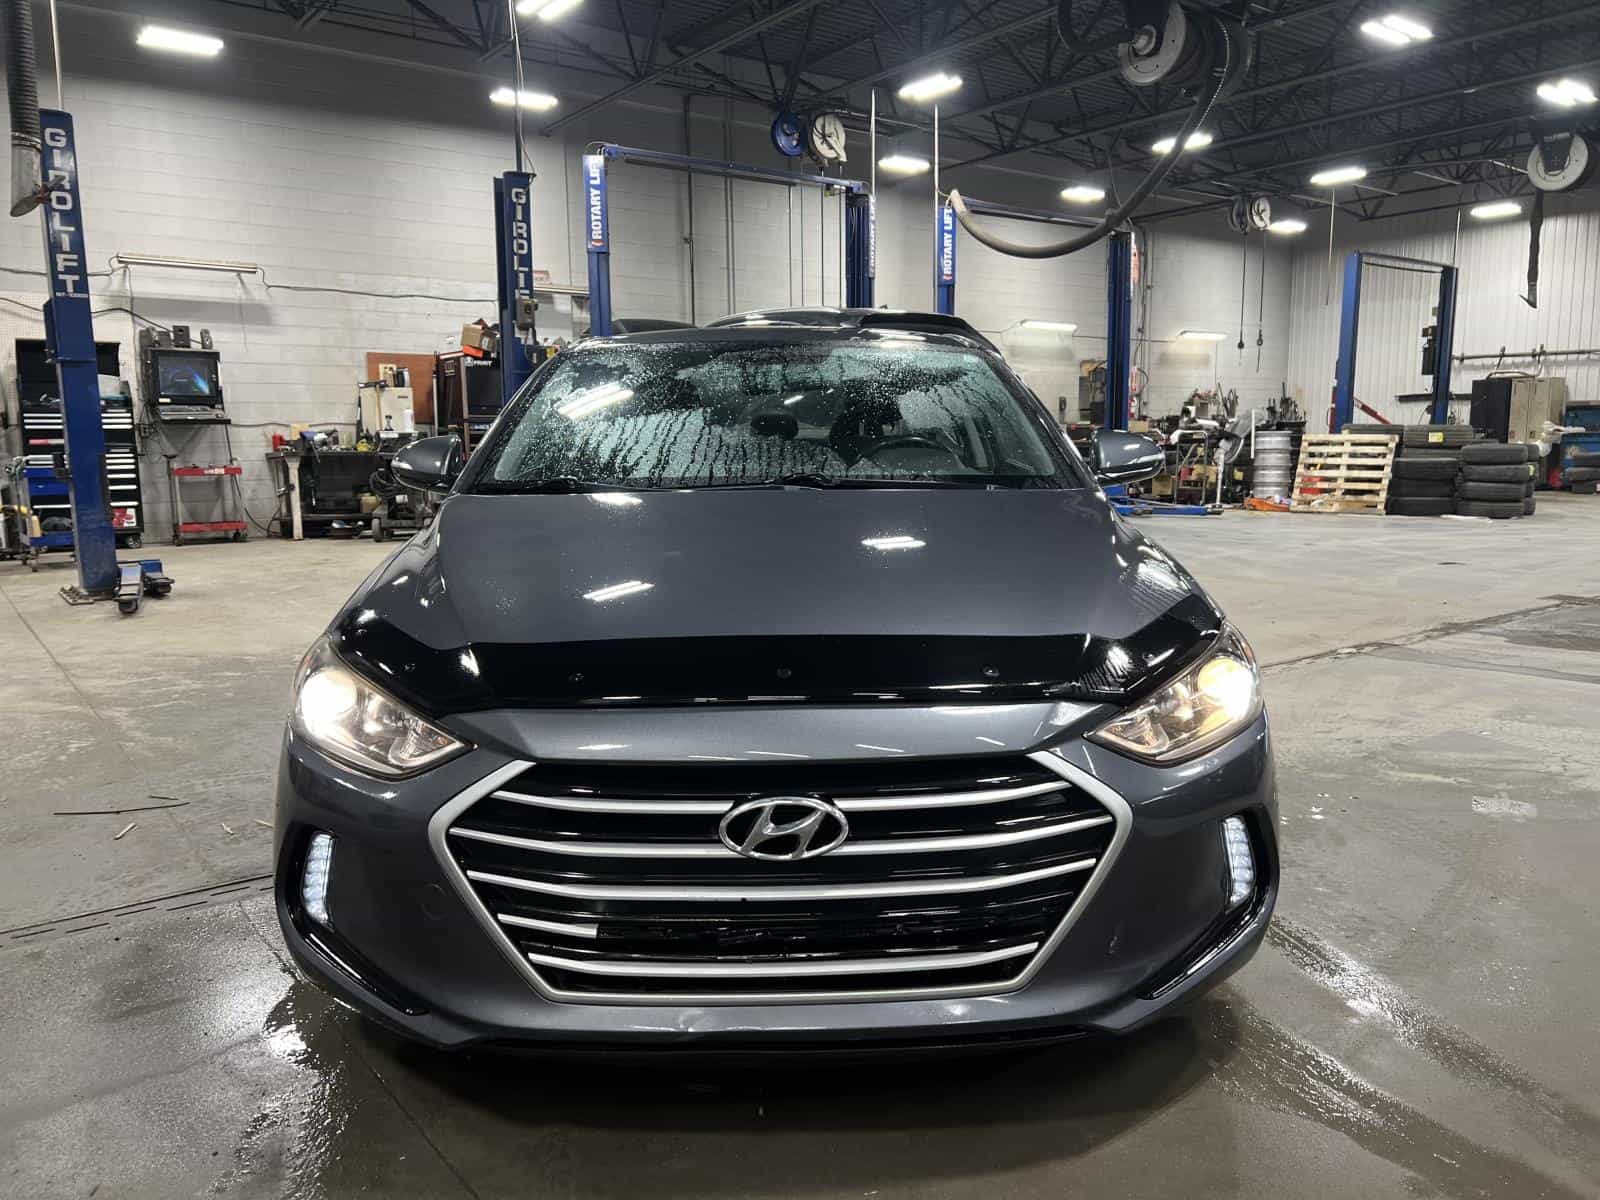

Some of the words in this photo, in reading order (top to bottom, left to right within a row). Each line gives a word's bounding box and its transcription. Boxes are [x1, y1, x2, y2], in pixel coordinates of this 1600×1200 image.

[44, 128, 80, 293] GIROLIFT
[511, 187, 531, 300] GIROLIF
[590, 187, 602, 240] ROTARY
[943, 232, 953, 275] ROTARY
